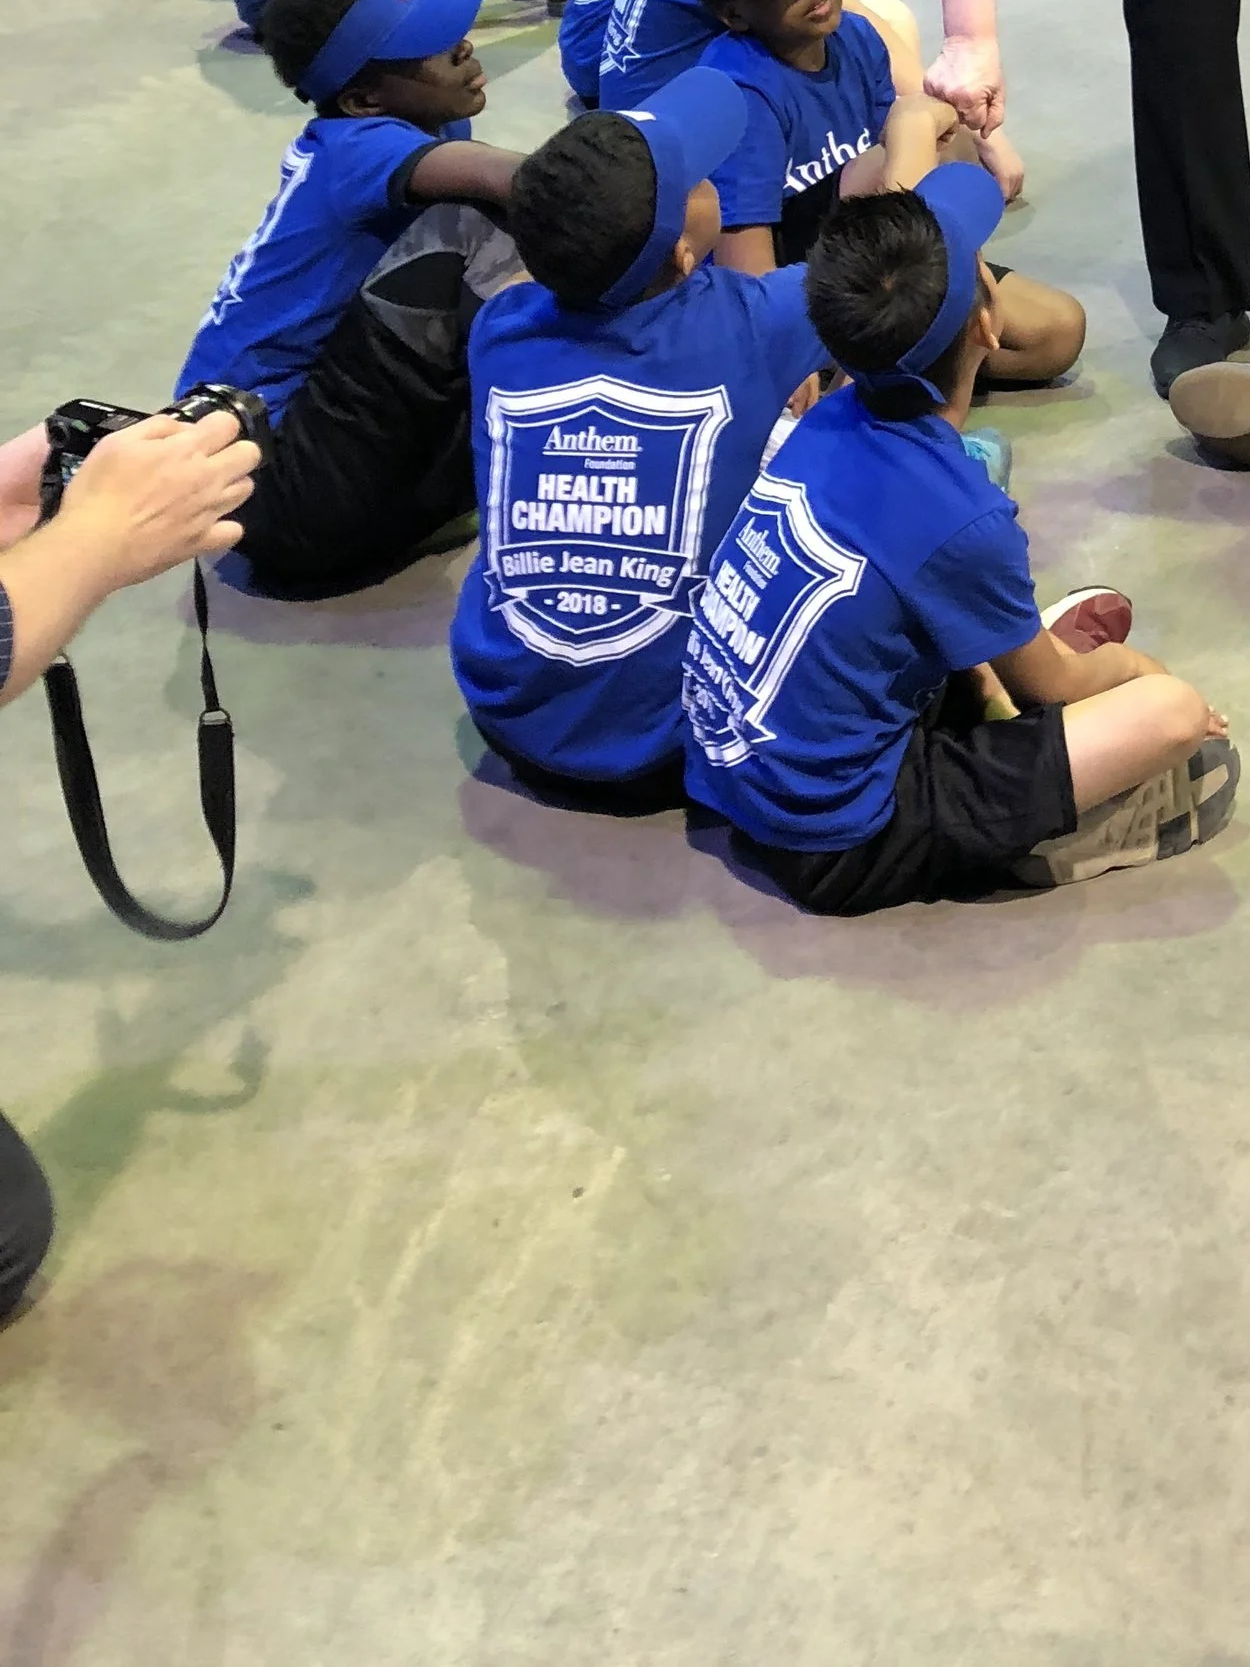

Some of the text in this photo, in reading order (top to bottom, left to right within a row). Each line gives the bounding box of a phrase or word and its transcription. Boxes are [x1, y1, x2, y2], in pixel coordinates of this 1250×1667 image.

[584, 458, 636, 470] Foundation
[537, 474, 637, 504] HEALTH
[511, 500, 666, 536] CHAMPION
[502, 551, 676, 587] Billie Jean King
[556, 591, 607, 615] 2018
